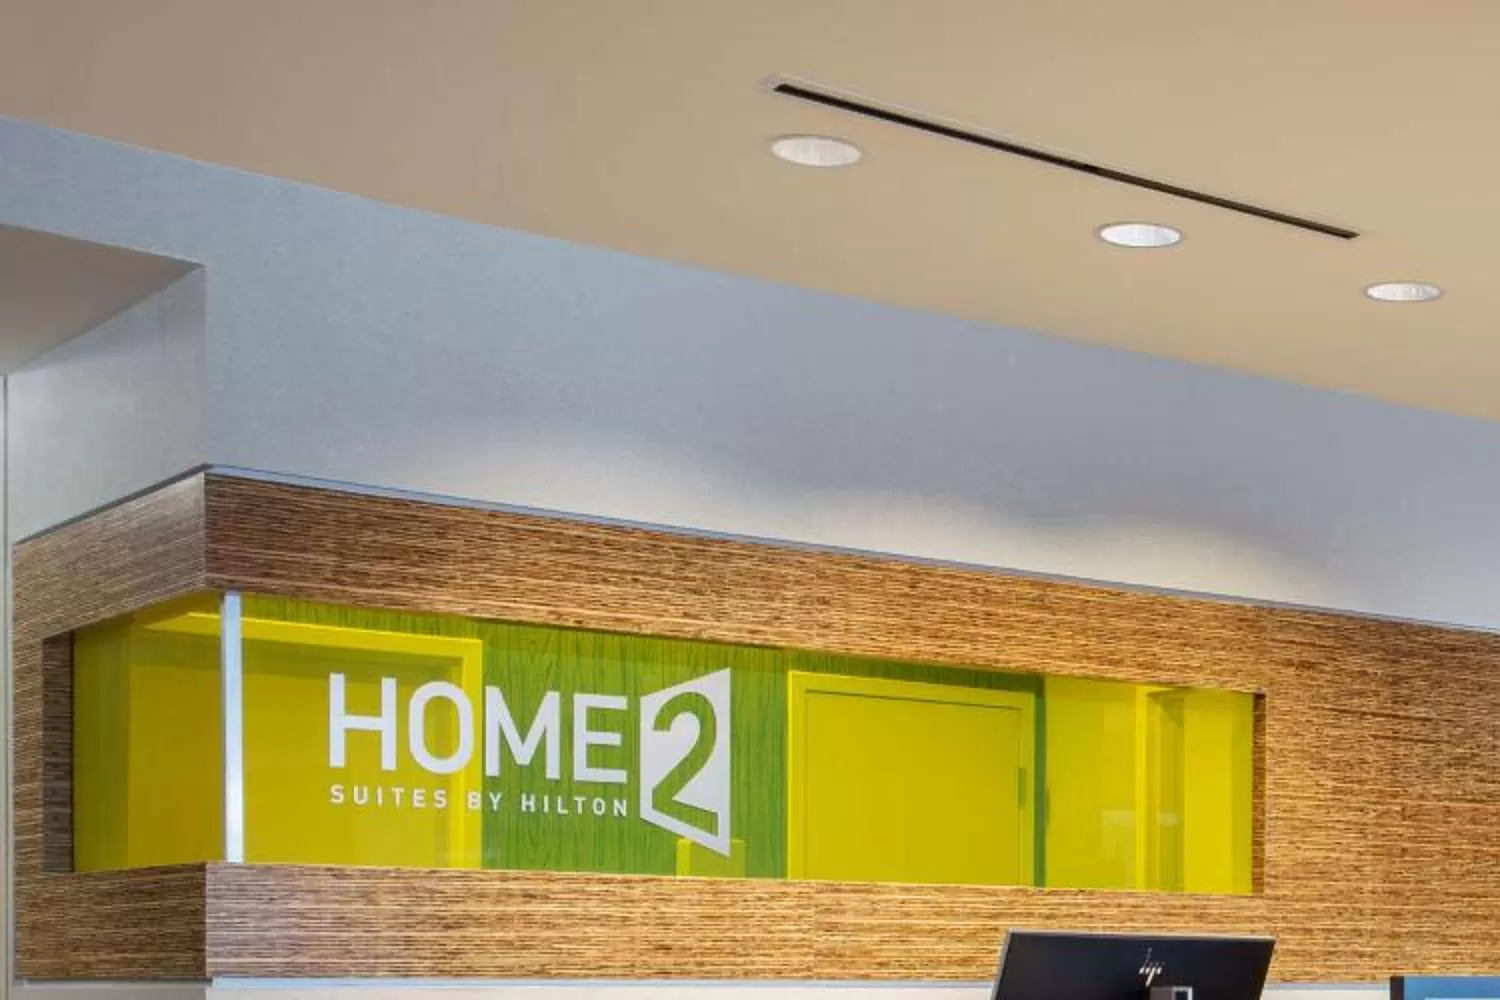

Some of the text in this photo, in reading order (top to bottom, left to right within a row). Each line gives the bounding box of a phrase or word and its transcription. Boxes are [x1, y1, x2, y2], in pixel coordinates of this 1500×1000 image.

[330, 784, 628, 817] SUITES BY HILTON
